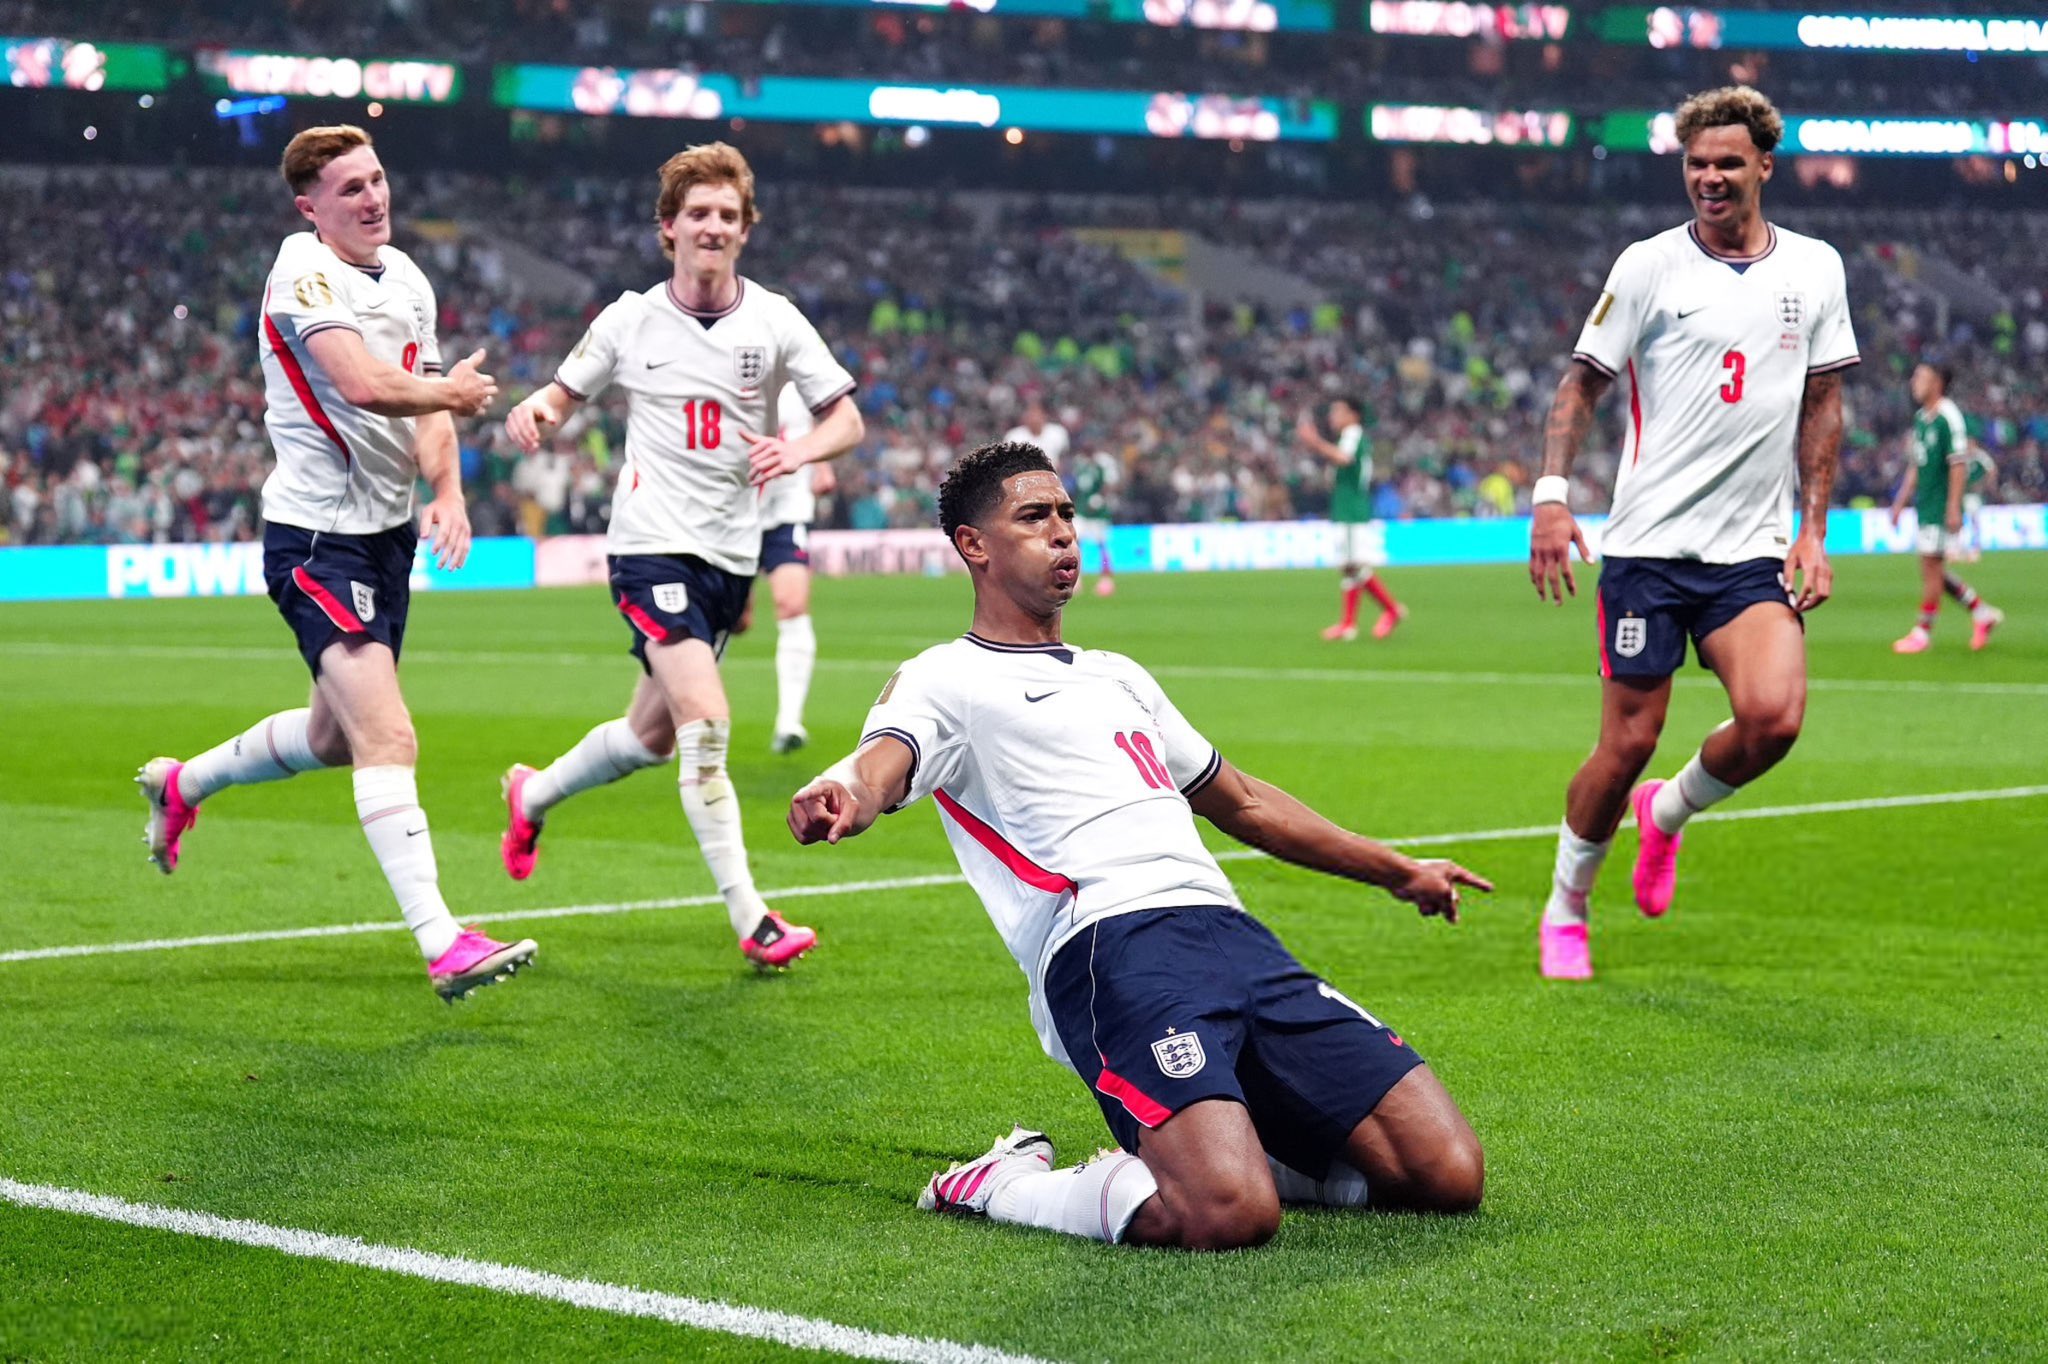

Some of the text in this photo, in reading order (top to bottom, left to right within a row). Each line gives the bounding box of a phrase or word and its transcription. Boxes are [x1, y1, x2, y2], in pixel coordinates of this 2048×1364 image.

[1720, 350, 1746, 404] 3
[682, 399, 721, 450] 18
[1113, 730, 1176, 791] 10
